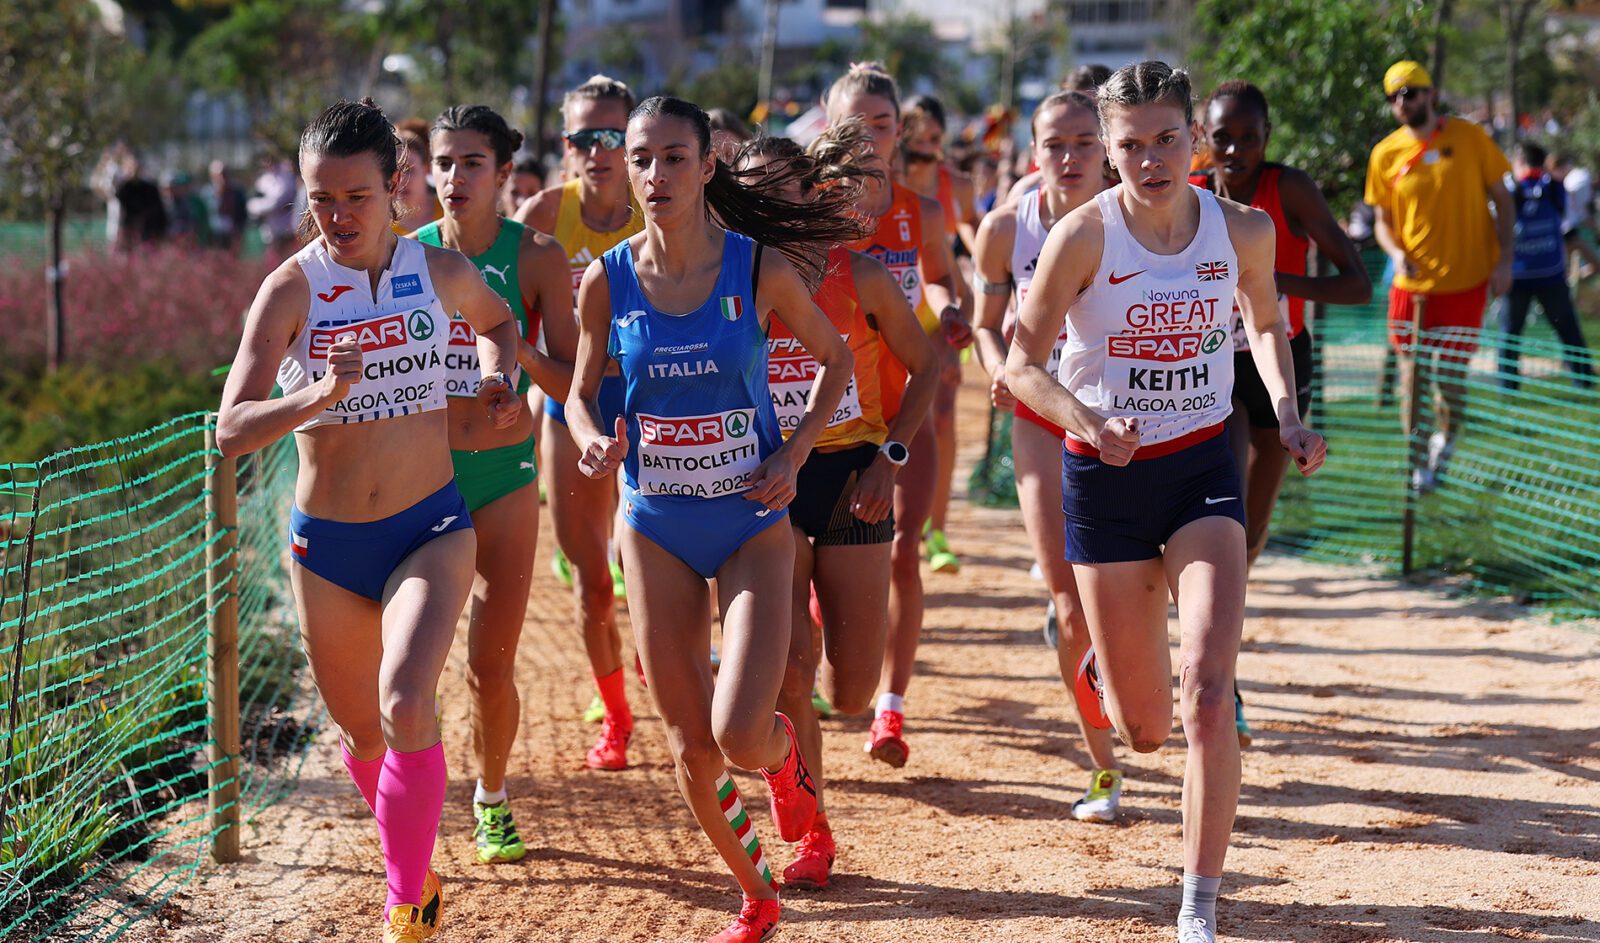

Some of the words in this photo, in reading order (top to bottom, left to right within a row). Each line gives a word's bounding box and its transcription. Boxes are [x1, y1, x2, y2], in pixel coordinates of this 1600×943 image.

[1143, 289, 1200, 302] Novuna
[1126, 298, 1219, 328] GREAT
[654, 342, 709, 353] FRECCIAROSSA
[1111, 336, 1200, 358] SPAR
[312, 344, 441, 383] HCHOVÁ
[648, 359, 719, 379] ITALIA
[768, 360, 819, 380] PAR
[1129, 363, 1209, 391] KEITH
[326, 391, 390, 413] AGOA
[1113, 395, 1177, 412] LAGOA
[1181, 391, 1216, 412] 2025
[828, 406, 851, 424] 25
[643, 418, 721, 443] SPAR
[642, 443, 756, 471] BATTOCLETTI
[648, 481, 708, 497] LAGOA
